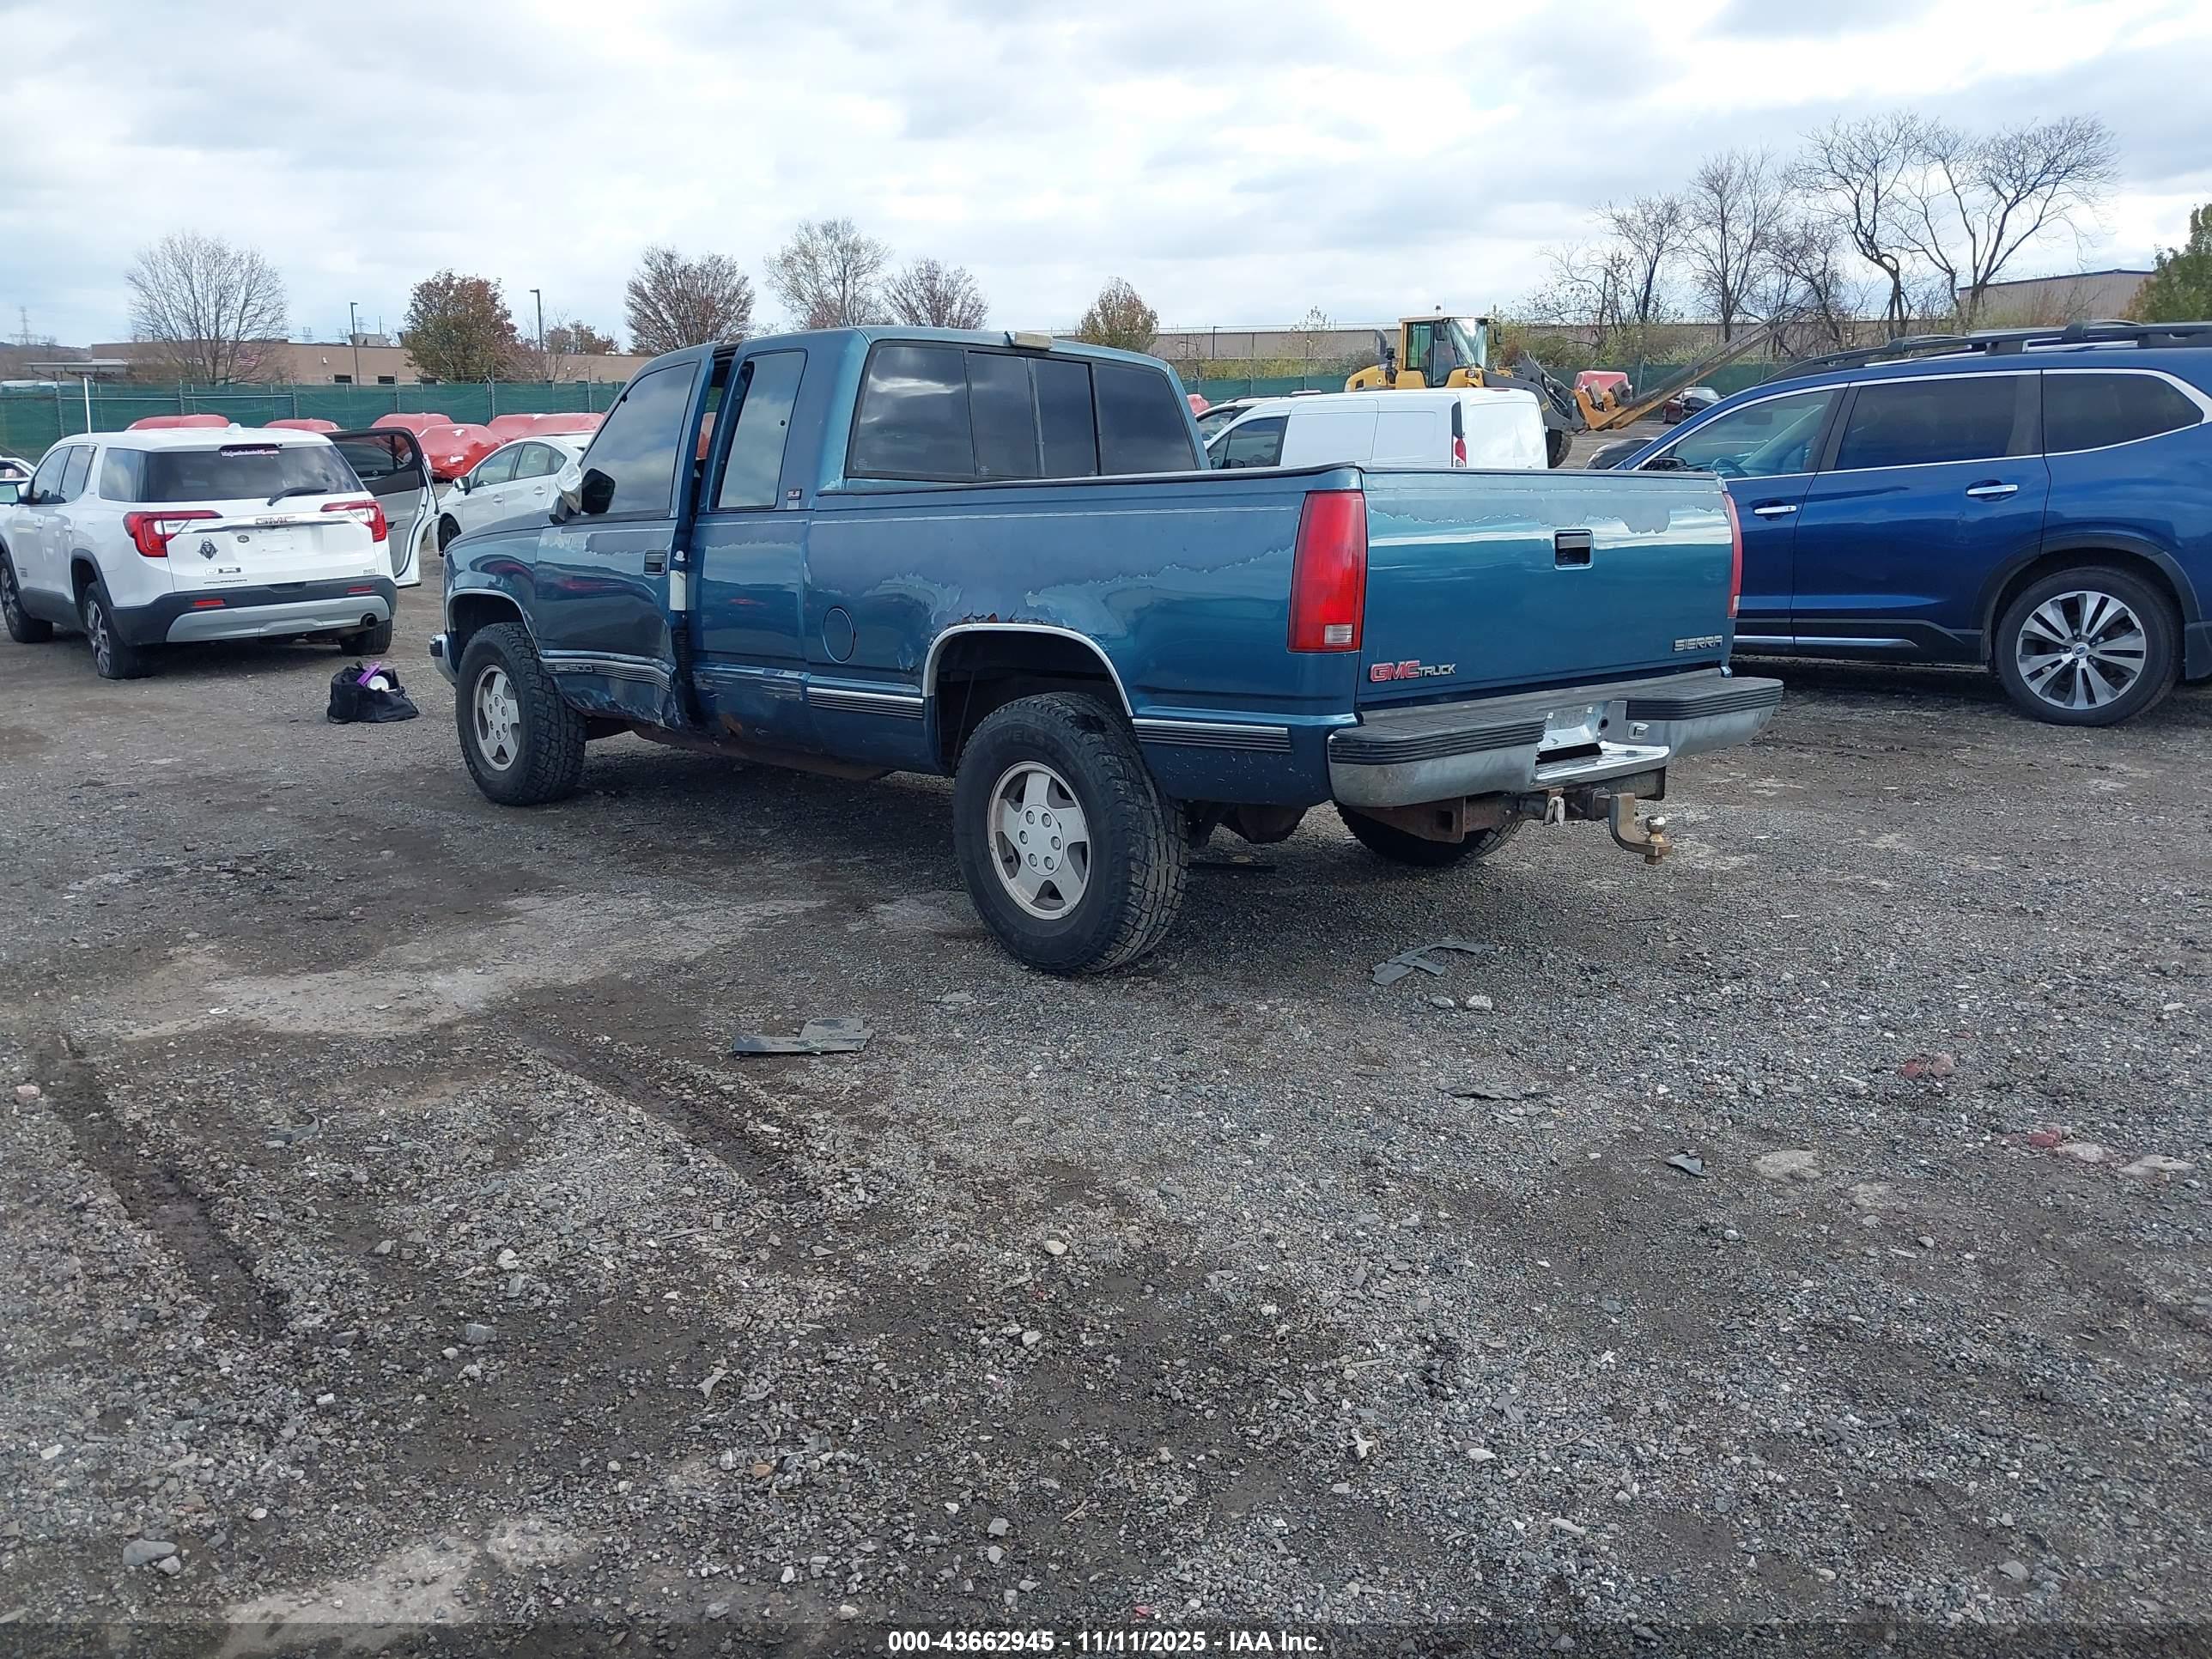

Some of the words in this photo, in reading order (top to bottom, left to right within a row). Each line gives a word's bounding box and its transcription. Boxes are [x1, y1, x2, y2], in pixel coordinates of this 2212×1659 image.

[1674, 635, 1723, 652] SIERRA
[1370, 659, 1420, 682] GMC
[1418, 663, 1457, 678] TRUCK
